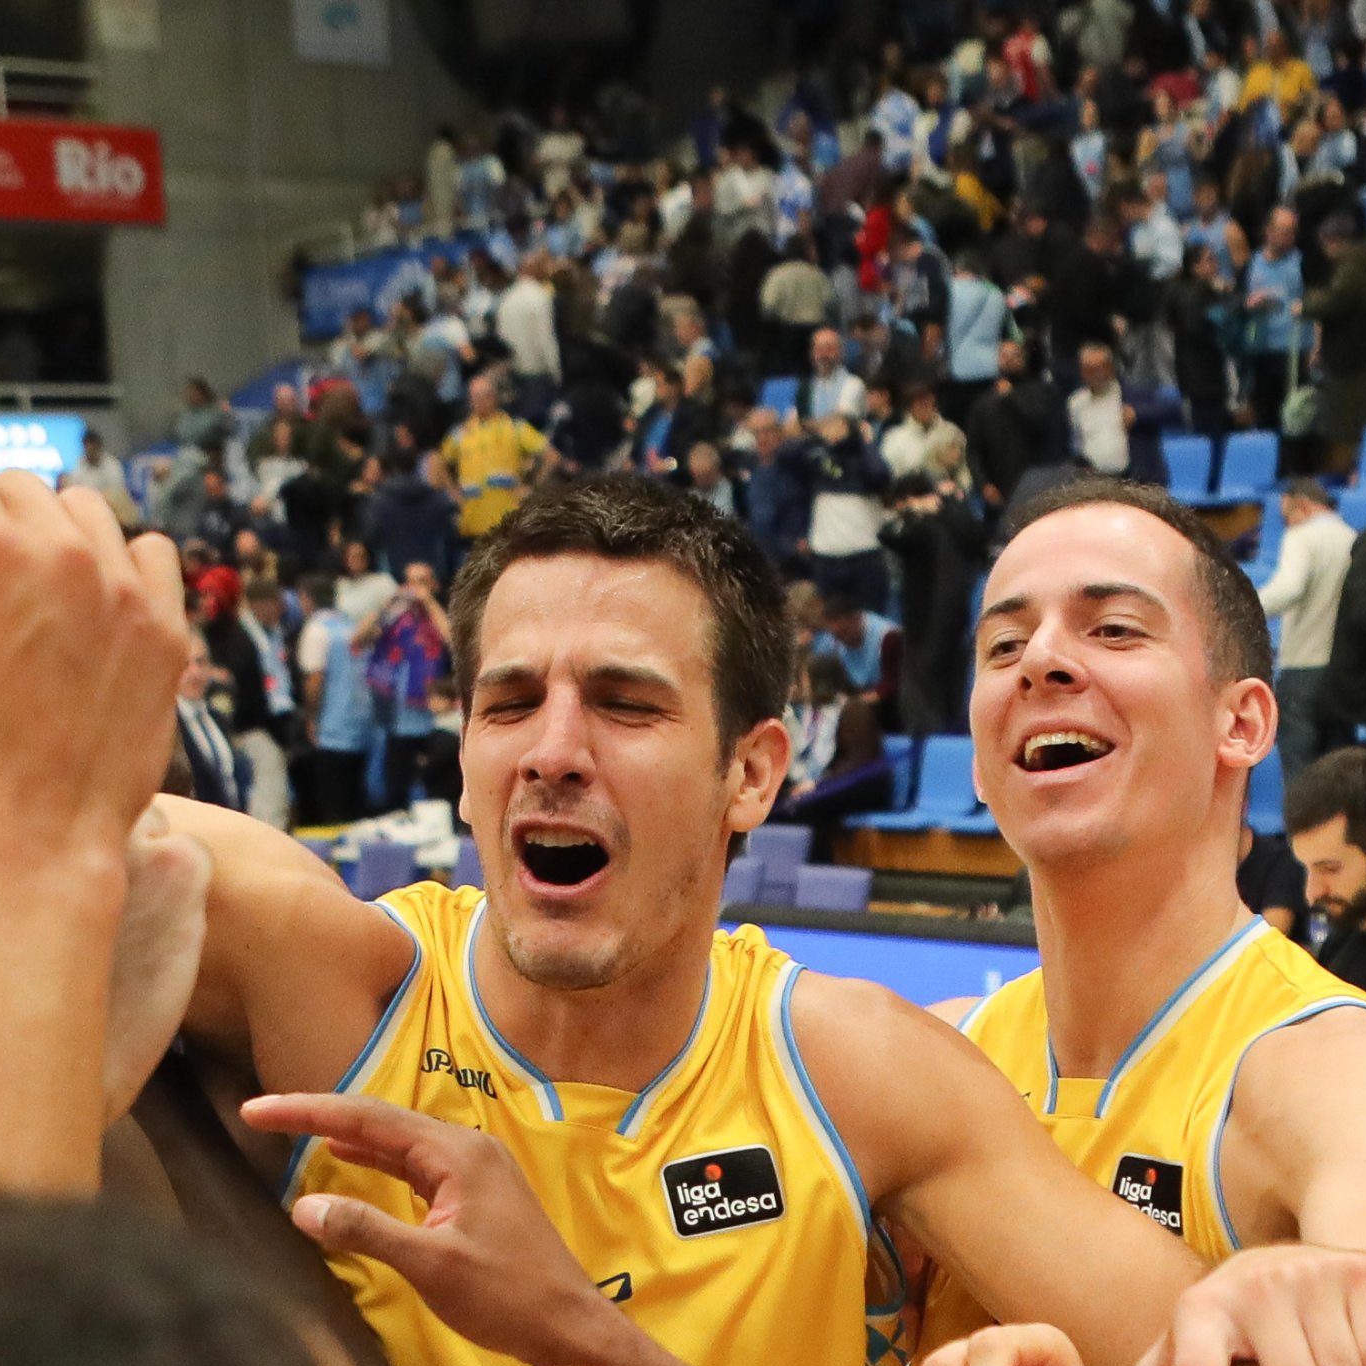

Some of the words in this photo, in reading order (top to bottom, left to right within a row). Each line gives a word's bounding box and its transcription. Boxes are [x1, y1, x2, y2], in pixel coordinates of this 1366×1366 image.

[676, 1181, 722, 1205] liga
[1118, 1176, 1152, 1202] liga
[683, 1192, 777, 1226] endesa
